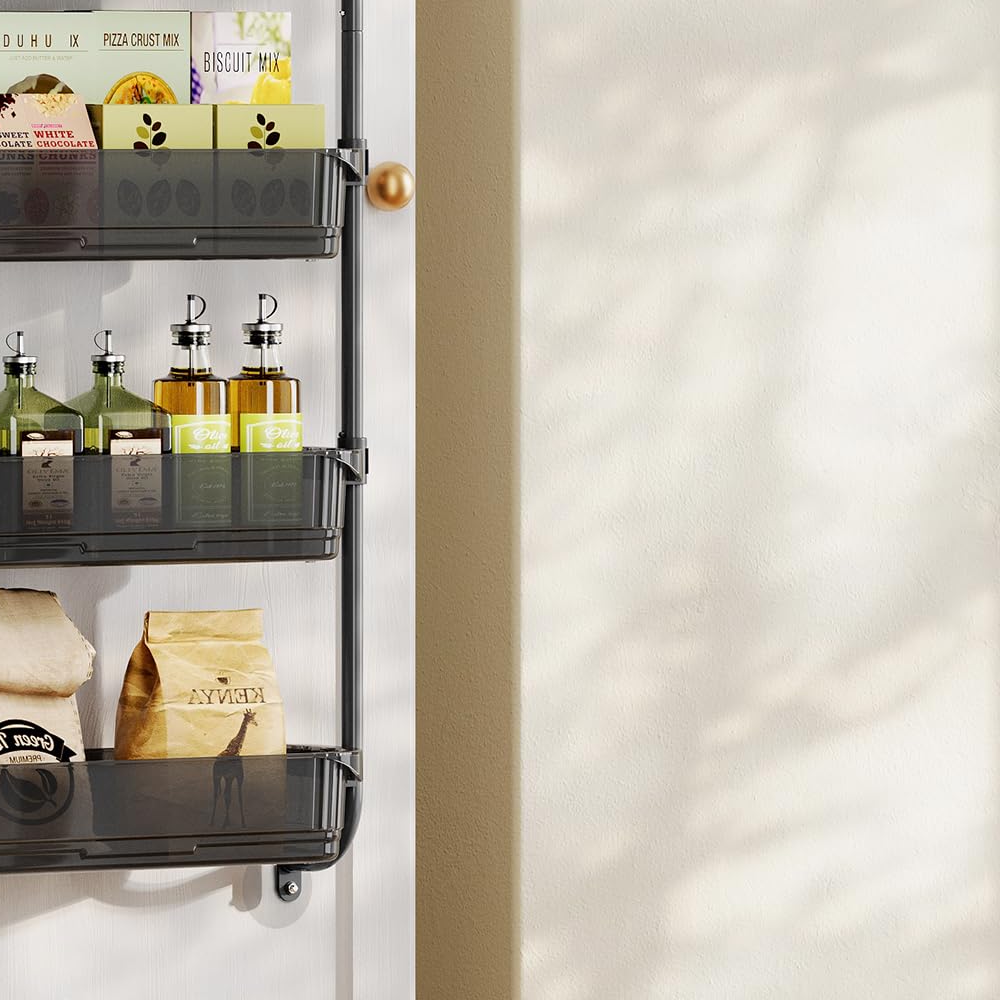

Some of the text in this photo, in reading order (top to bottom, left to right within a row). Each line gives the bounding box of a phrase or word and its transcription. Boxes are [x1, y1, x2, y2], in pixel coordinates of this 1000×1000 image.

[103, 33, 180, 47] PIZZA CRUST MIX
[204, 51, 280, 73] BISCUIT MIX
[33, 130, 75, 139] WHITE
[36, 140, 95, 148] CHOCOLATE
[39, 150, 97, 161] CHUNKS
